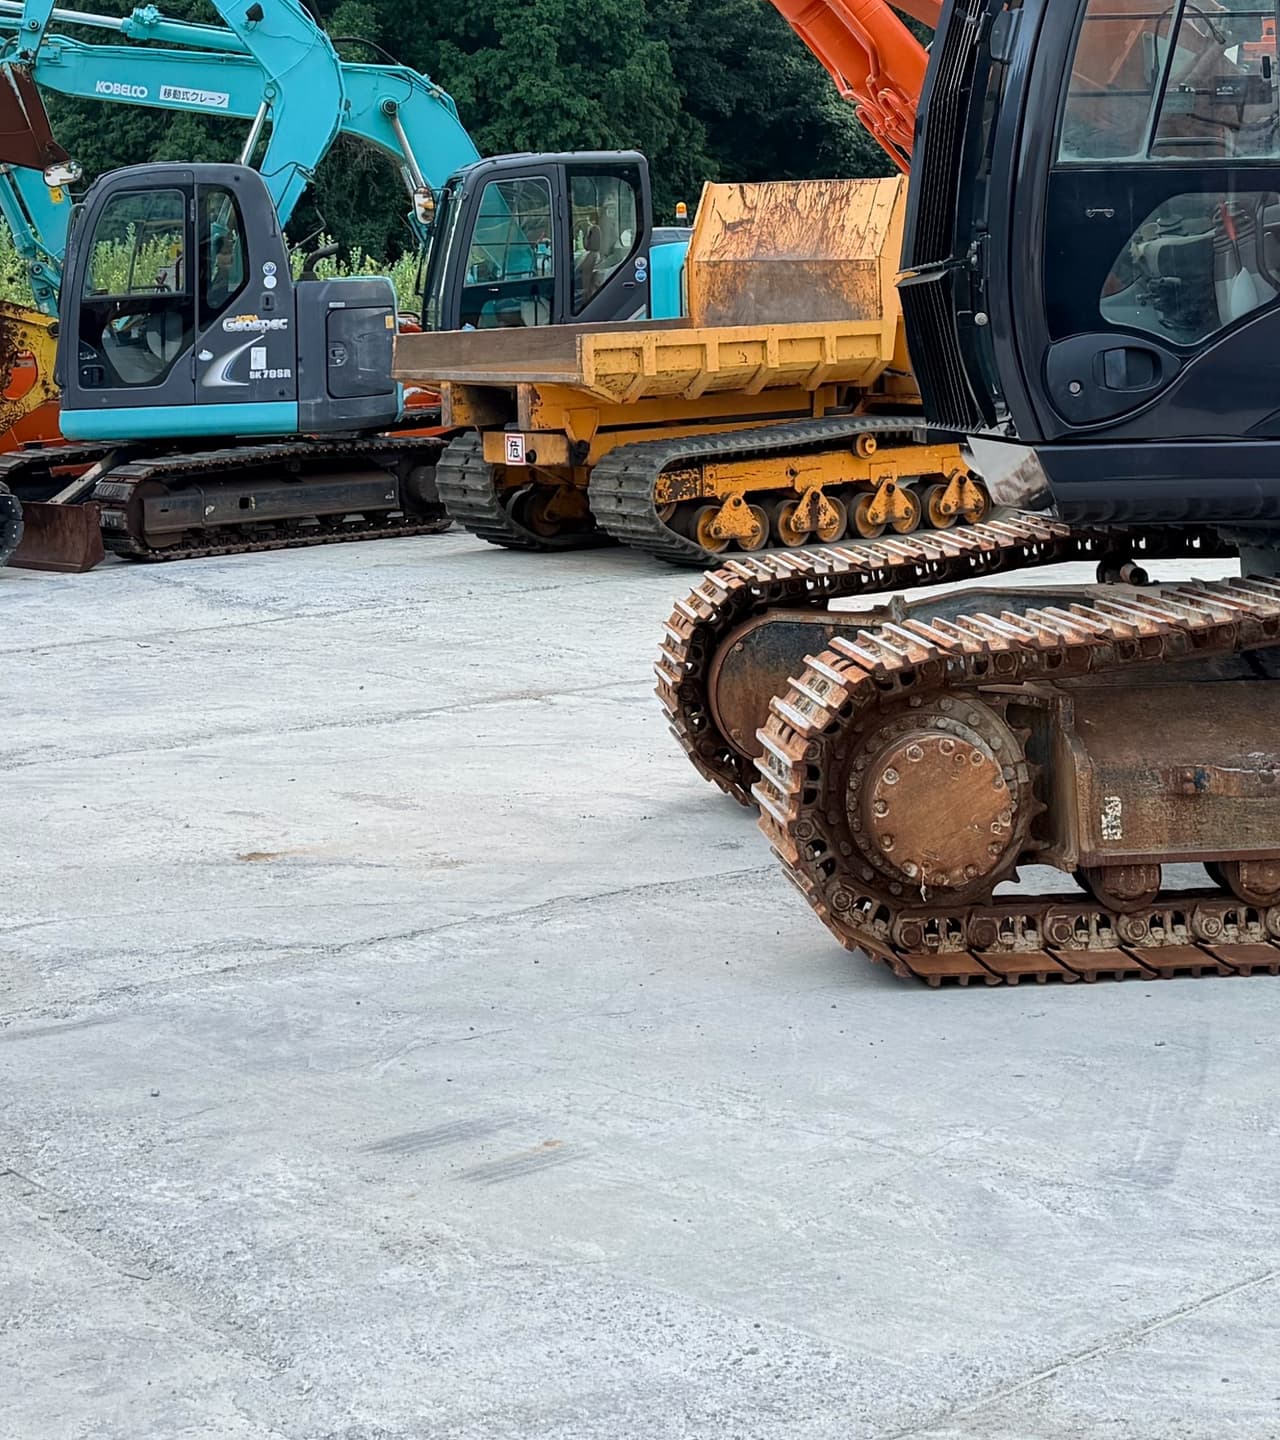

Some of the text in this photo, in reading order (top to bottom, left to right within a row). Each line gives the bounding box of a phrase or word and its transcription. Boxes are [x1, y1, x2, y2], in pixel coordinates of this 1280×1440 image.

[96, 80, 149, 98] KOBELCO
[163, 88, 226, 105] 移動式クレーン
[510, 440, 520, 458] 危
